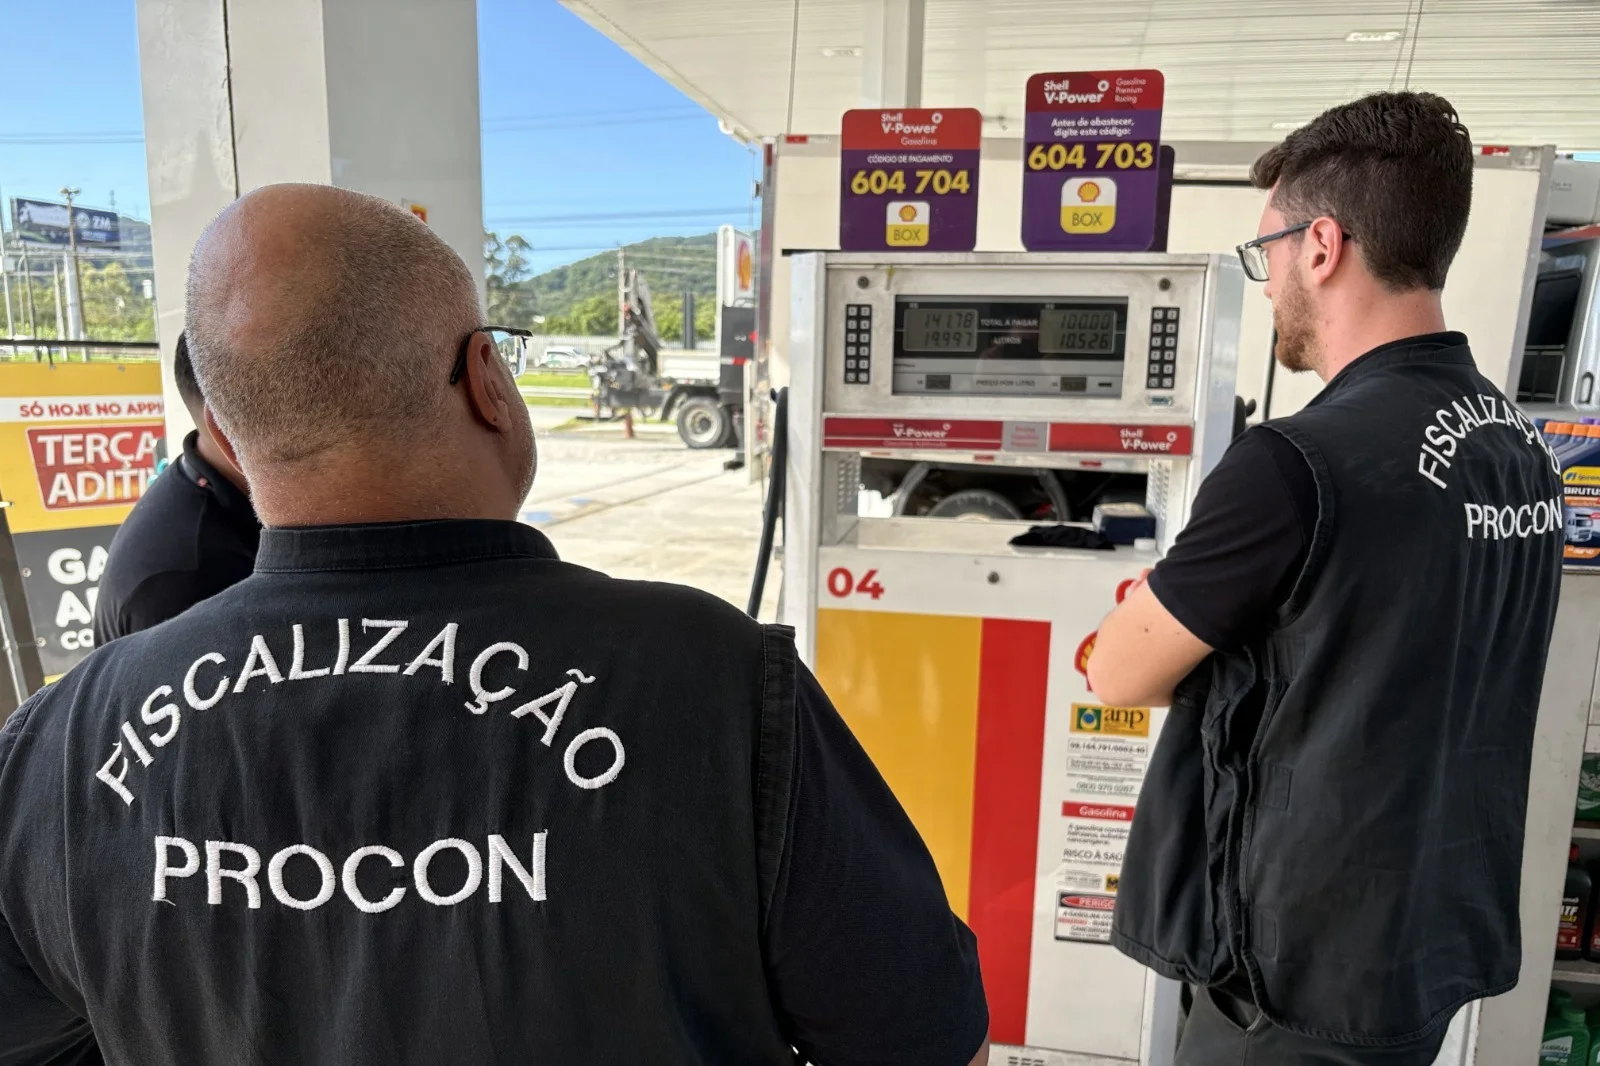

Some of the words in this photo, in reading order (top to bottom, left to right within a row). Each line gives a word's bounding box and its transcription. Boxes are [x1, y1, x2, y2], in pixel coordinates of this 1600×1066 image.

[1044, 79, 1069, 91] Shell
[1115, 77, 1147, 86] Gasolina
[1115, 86, 1143, 94] Premium
[1044, 92, 1104, 104] V-Power
[1114, 94, 1138, 104] Racing
[881, 112, 903, 123] Shell
[1051, 118, 1076, 127] Antes
[1077, 117, 1089, 127] de
[1090, 117, 1135, 127] abastecer,
[881, 122, 938, 134] V-Power
[1054, 127, 1078, 138] digite
[1079, 128, 1098, 136] este
[1099, 126, 1132, 138] código:
[900, 136, 938, 146] Gasolina
[867, 153, 898, 163] CÓDIGO
[898, 154, 907, 163] DE
[909, 154, 953, 163] PAGAMENTO
[1028, 144, 1086, 171] 604
[1095, 143, 1153, 170] 703
[851, 169, 906, 195] 604
[915, 168, 970, 194] 704
[1072, 212, 1102, 226] BOX
[893, 228, 920, 241] BOX
[980, 318, 1003, 327] TOTAL
[1004, 318, 1011, 327] A
[1012, 319, 1038, 327] PAGAR
[993, 336, 1021, 345] LITROS
[19, 400, 45, 417] SÓ
[48, 403, 93, 417] HOJE
[96, 403, 121, 416] NO
[893, 428, 948, 438] V-Power
[1120, 428, 1143, 438] Shell
[37, 431, 154, 470] TERÇA
[1121, 439, 1172, 451] V-Power
[48, 464, 156, 506] ADITI
[1464, 494, 1563, 540] PROCON
[827, 566, 885, 600] 04
[96, 618, 625, 806] FISCALIZAÇÃO
[1104, 707, 1144, 729] anp
[1079, 806, 1127, 819] Gasolina
[1063, 848, 1094, 860] RISCO
[153, 829, 548, 913] PROCON
